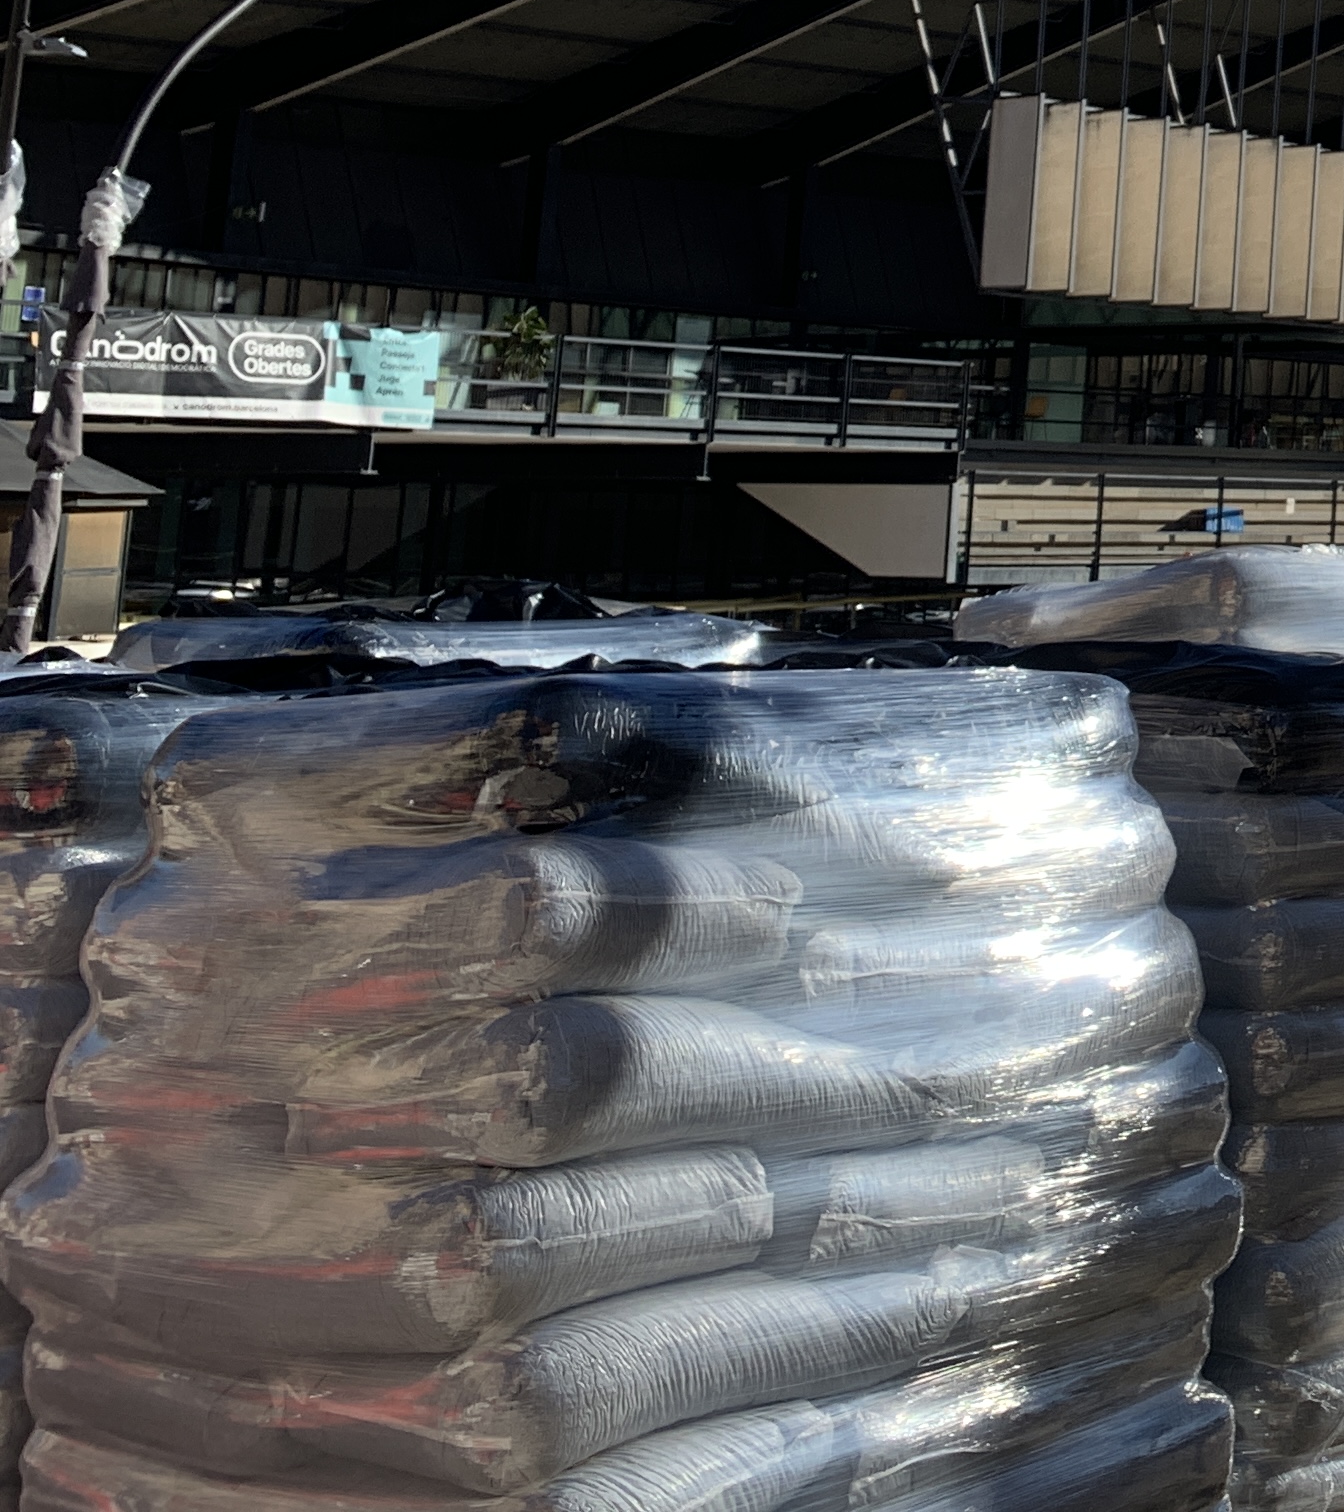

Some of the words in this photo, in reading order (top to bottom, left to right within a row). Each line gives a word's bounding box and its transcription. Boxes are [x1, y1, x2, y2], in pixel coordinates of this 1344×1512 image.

[50, 330, 218, 364] Cnòdrom
[243, 339, 305, 359] Grades
[243, 357, 312, 378] Obertes
